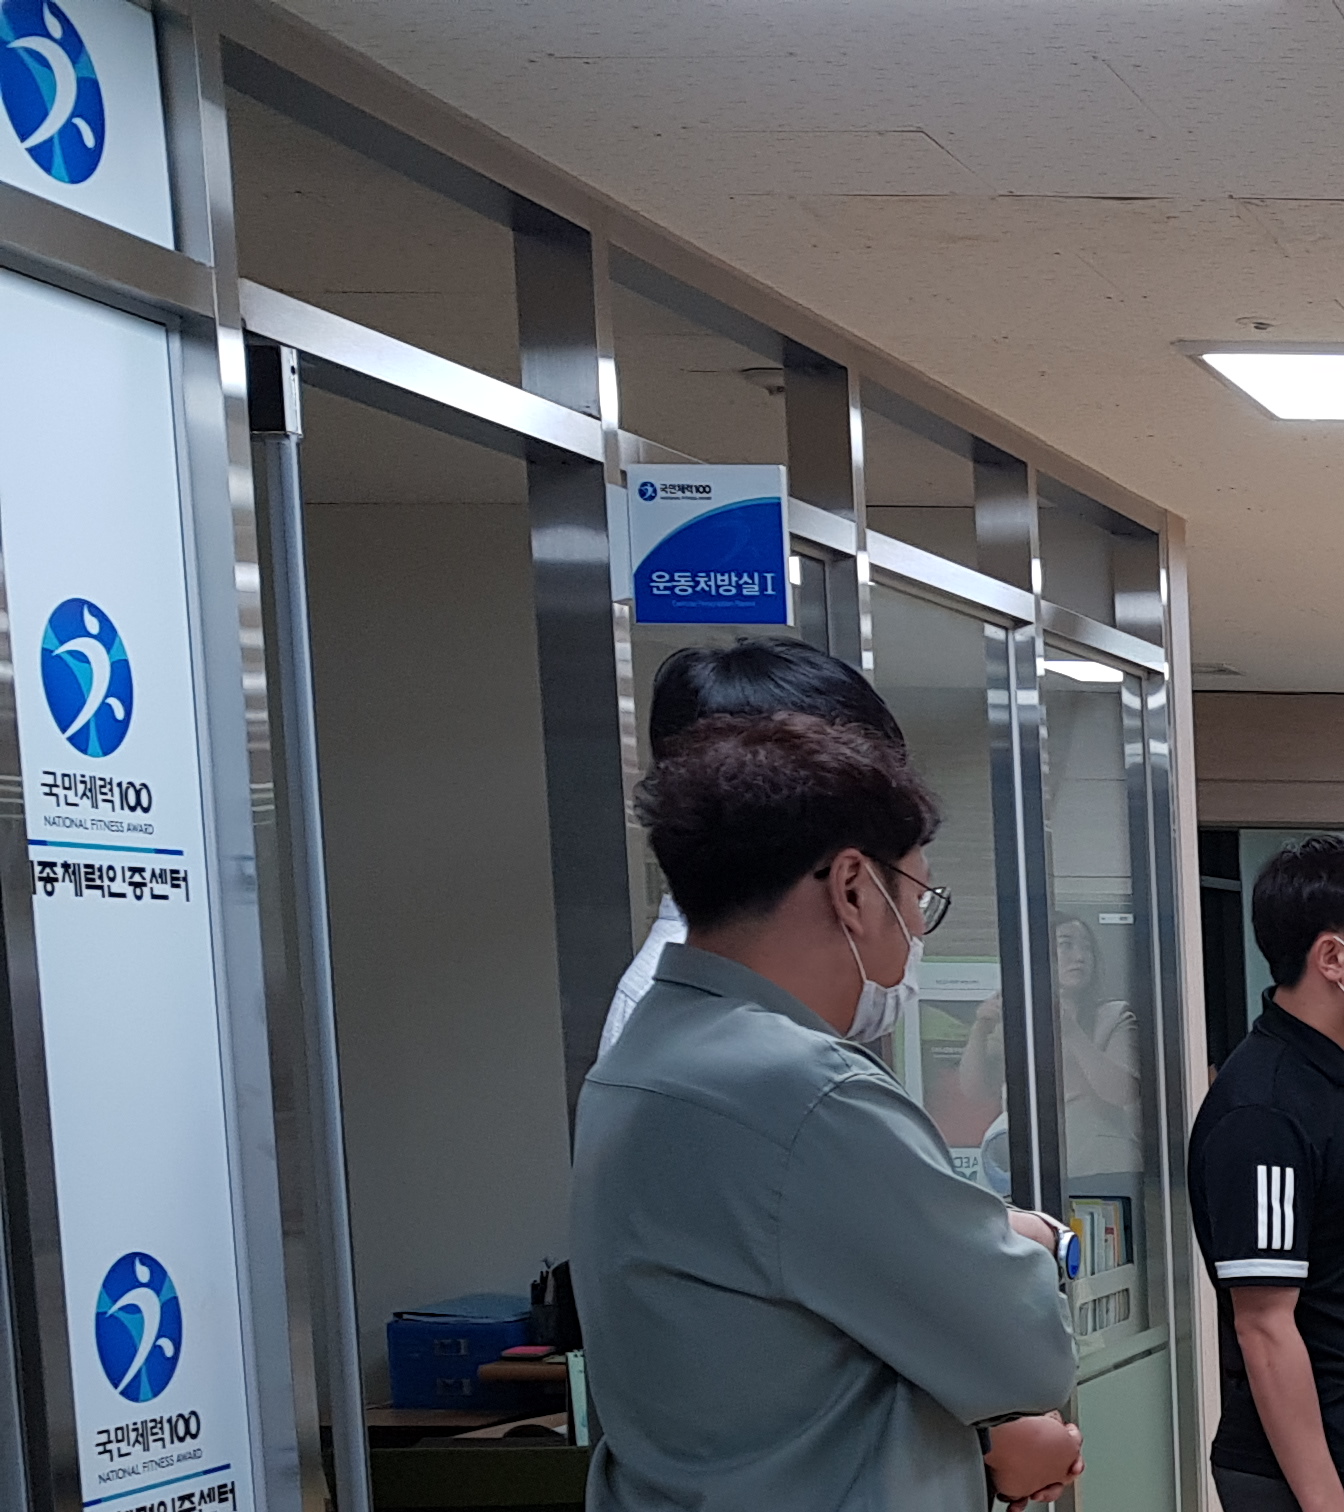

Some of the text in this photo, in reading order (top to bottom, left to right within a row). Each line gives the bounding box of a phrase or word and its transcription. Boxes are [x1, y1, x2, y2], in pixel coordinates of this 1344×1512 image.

[41, 770, 153, 813] 국민체력100
[43, 815, 155, 835] NATIONAL FITNESS AWARD
[95, 1410, 202, 1462] 국민체력100
[97, 1448, 204, 1485] NATIONAL FITNESS AWARD
